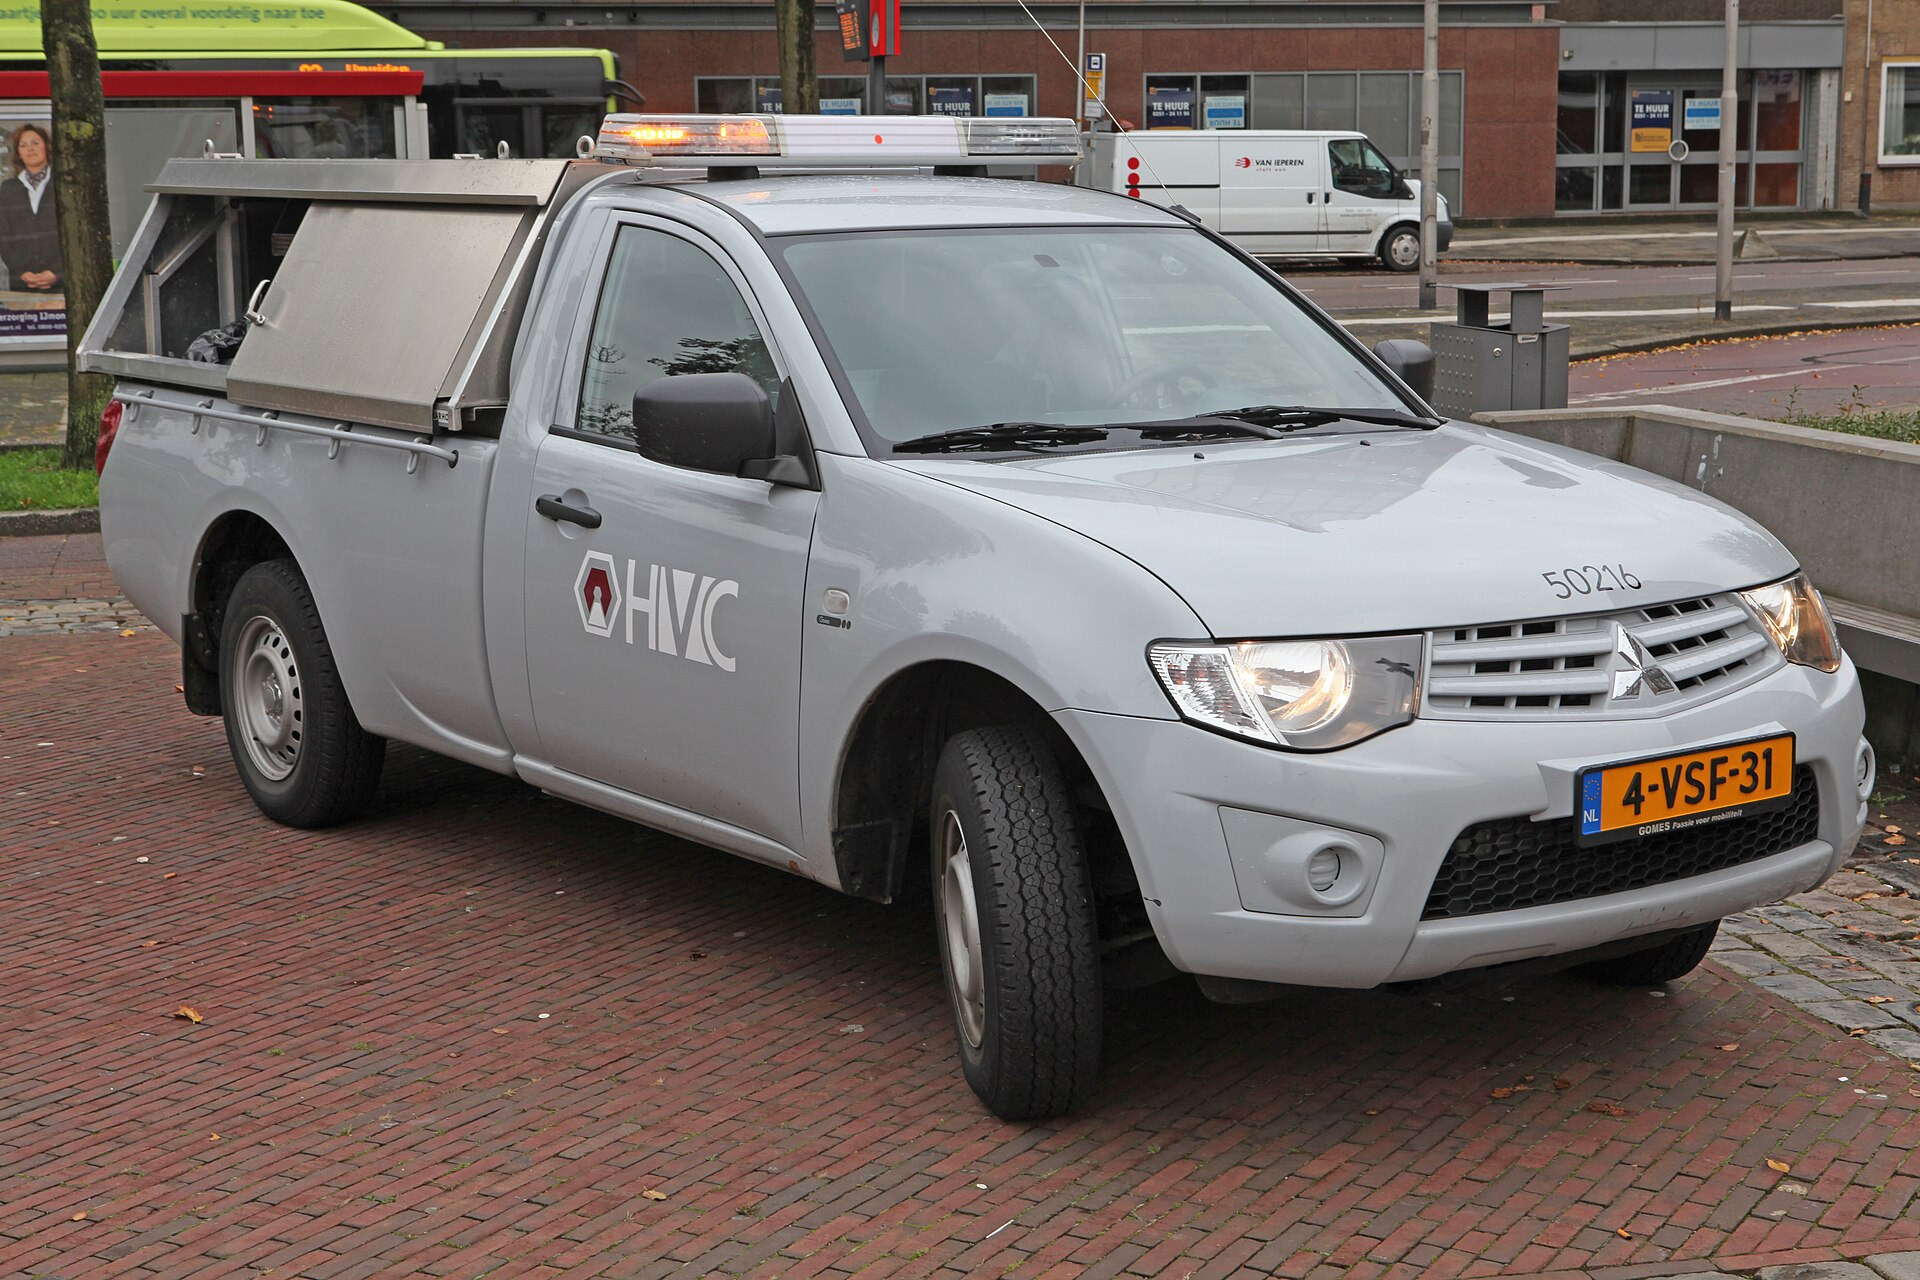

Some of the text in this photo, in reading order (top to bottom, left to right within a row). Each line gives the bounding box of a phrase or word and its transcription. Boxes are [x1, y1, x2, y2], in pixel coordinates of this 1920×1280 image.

[110, 9, 136, 19] uur
[140, 6, 187, 19] overal
[190, 6, 260, 23] voordelig
[263, 9, 297, 19] naar
[301, 7, 325, 19] toe
[762, 103, 773, 111] TE
[831, 100, 854, 108] HUUR
[932, 103, 971, 111] TE HUUR
[1152, 102, 1190, 110] TE HUUR
[1634, 104, 1670, 112] TE HUUR
[1541, 563, 1642, 599] 50216
[625, 558, 739, 672] HVC
[1583, 748, 1773, 824] NL 4-VSF-31
[1638, 808, 1743, 836] GOMES Passie voor mobiliteit
